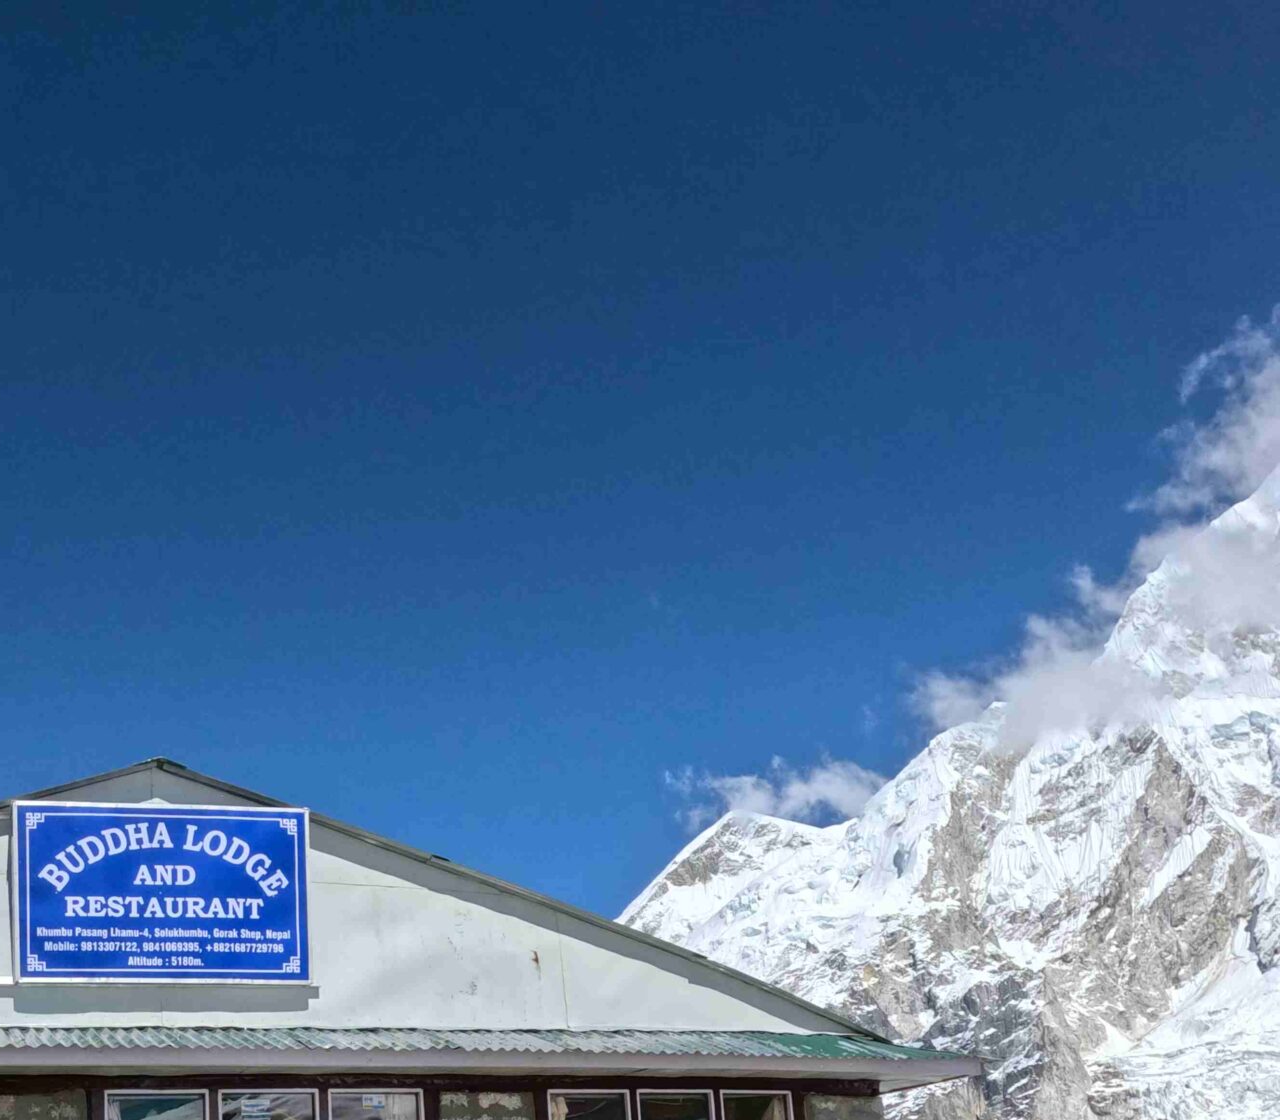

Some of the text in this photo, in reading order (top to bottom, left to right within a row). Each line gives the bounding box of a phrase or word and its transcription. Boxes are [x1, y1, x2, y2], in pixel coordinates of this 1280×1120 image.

[37, 821, 290, 897] BUDDHA LODGE
[133, 864, 197, 886] AND
[64, 896, 264, 920] RESTAURANT
[36, 926, 291, 940] Khumbu Pasang Lhamu-4, Solukhumbu, Gorak Shep, Nepal
[44, 940, 285, 953] Mobile: 9813307122, 9841069395, +8821687729796
[128, 955, 163, 966] Altitude
[171, 956, 205, 966] 5180m.
